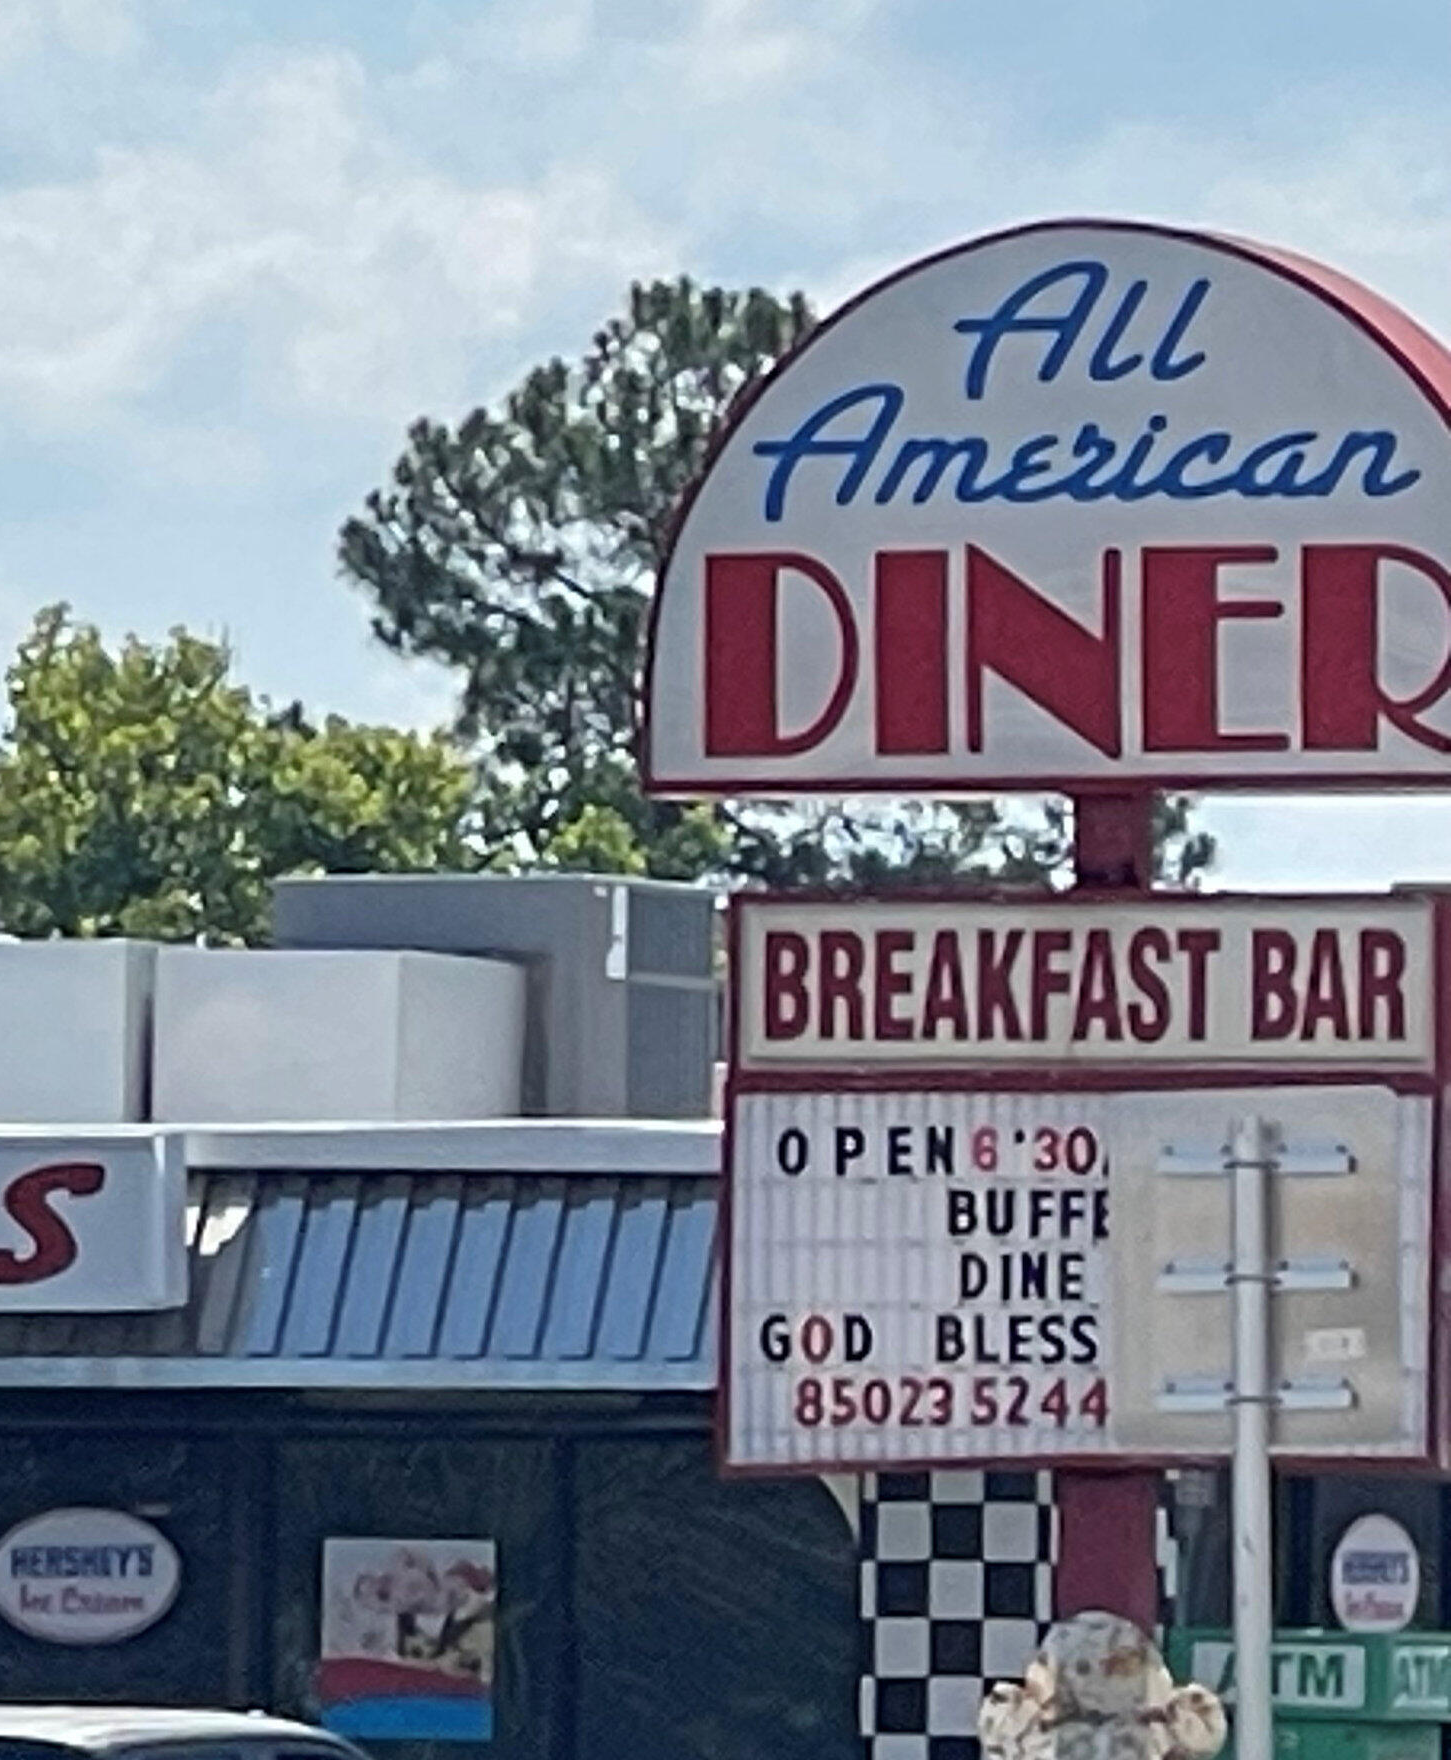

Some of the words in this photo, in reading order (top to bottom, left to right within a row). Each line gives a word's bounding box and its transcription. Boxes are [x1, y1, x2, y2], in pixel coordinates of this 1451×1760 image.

[955, 261, 1212, 399] All
[754, 384, 1421, 521] American
[704, 543, 1451, 760] DINER
[764, 928, 1221, 1041] BREAKFAST
[1250, 928, 1406, 1041] BAR
[777, 1126, 954, 1177] OPEN
[960, 1251, 1085, 1300] DINE
[760, 1313, 873, 1362] GOD
[936, 1314, 1097, 1363] BLESS
